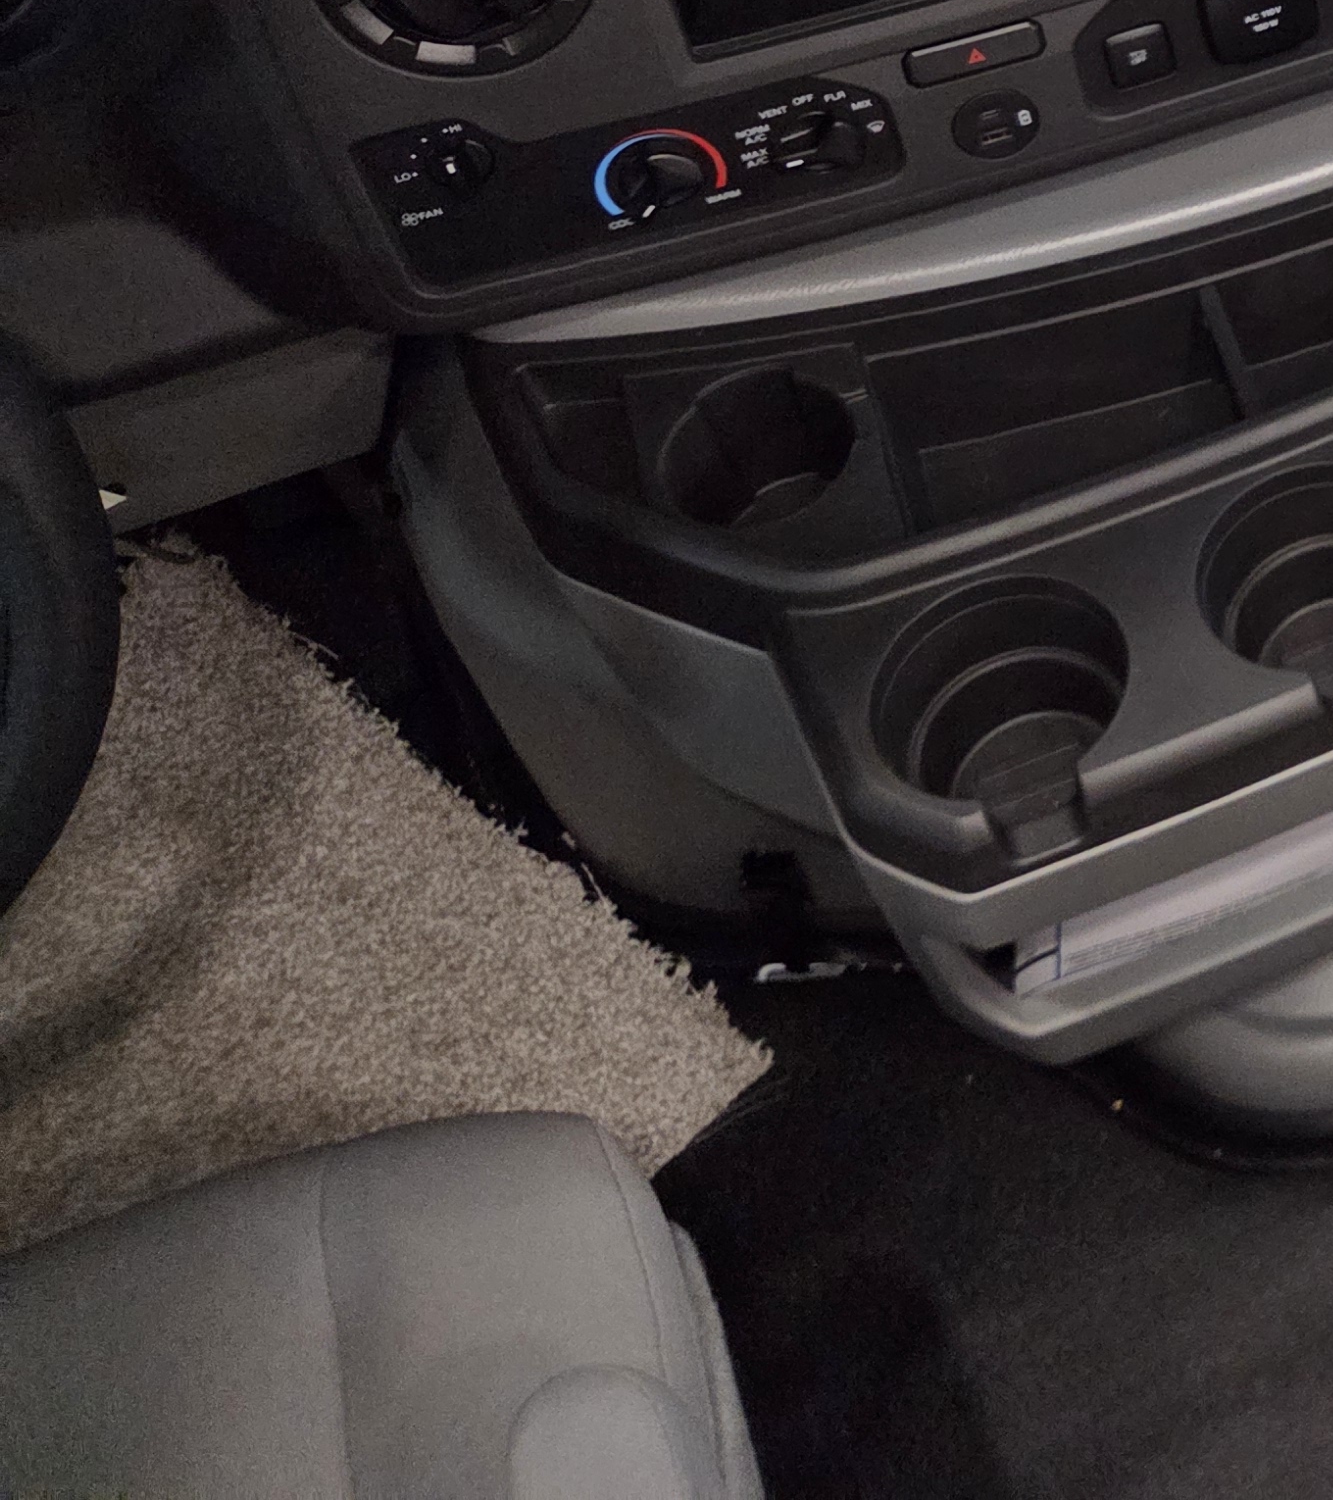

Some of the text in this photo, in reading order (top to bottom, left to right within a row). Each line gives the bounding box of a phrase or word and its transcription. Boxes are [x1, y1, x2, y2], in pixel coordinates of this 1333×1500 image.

[791, 93, 814, 107] OFF
[850, 99, 873, 111] MIX
[758, 105, 788, 120] VENT
[449, 123, 462, 133] HI
[735, 124, 771, 140] NORM
[744, 133, 768, 146] A/C
[740, 148, 769, 162] MAX
[746, 155, 770, 169] A/C
[394, 172, 411, 184] LO
[418, 207, 444, 221] FAN
